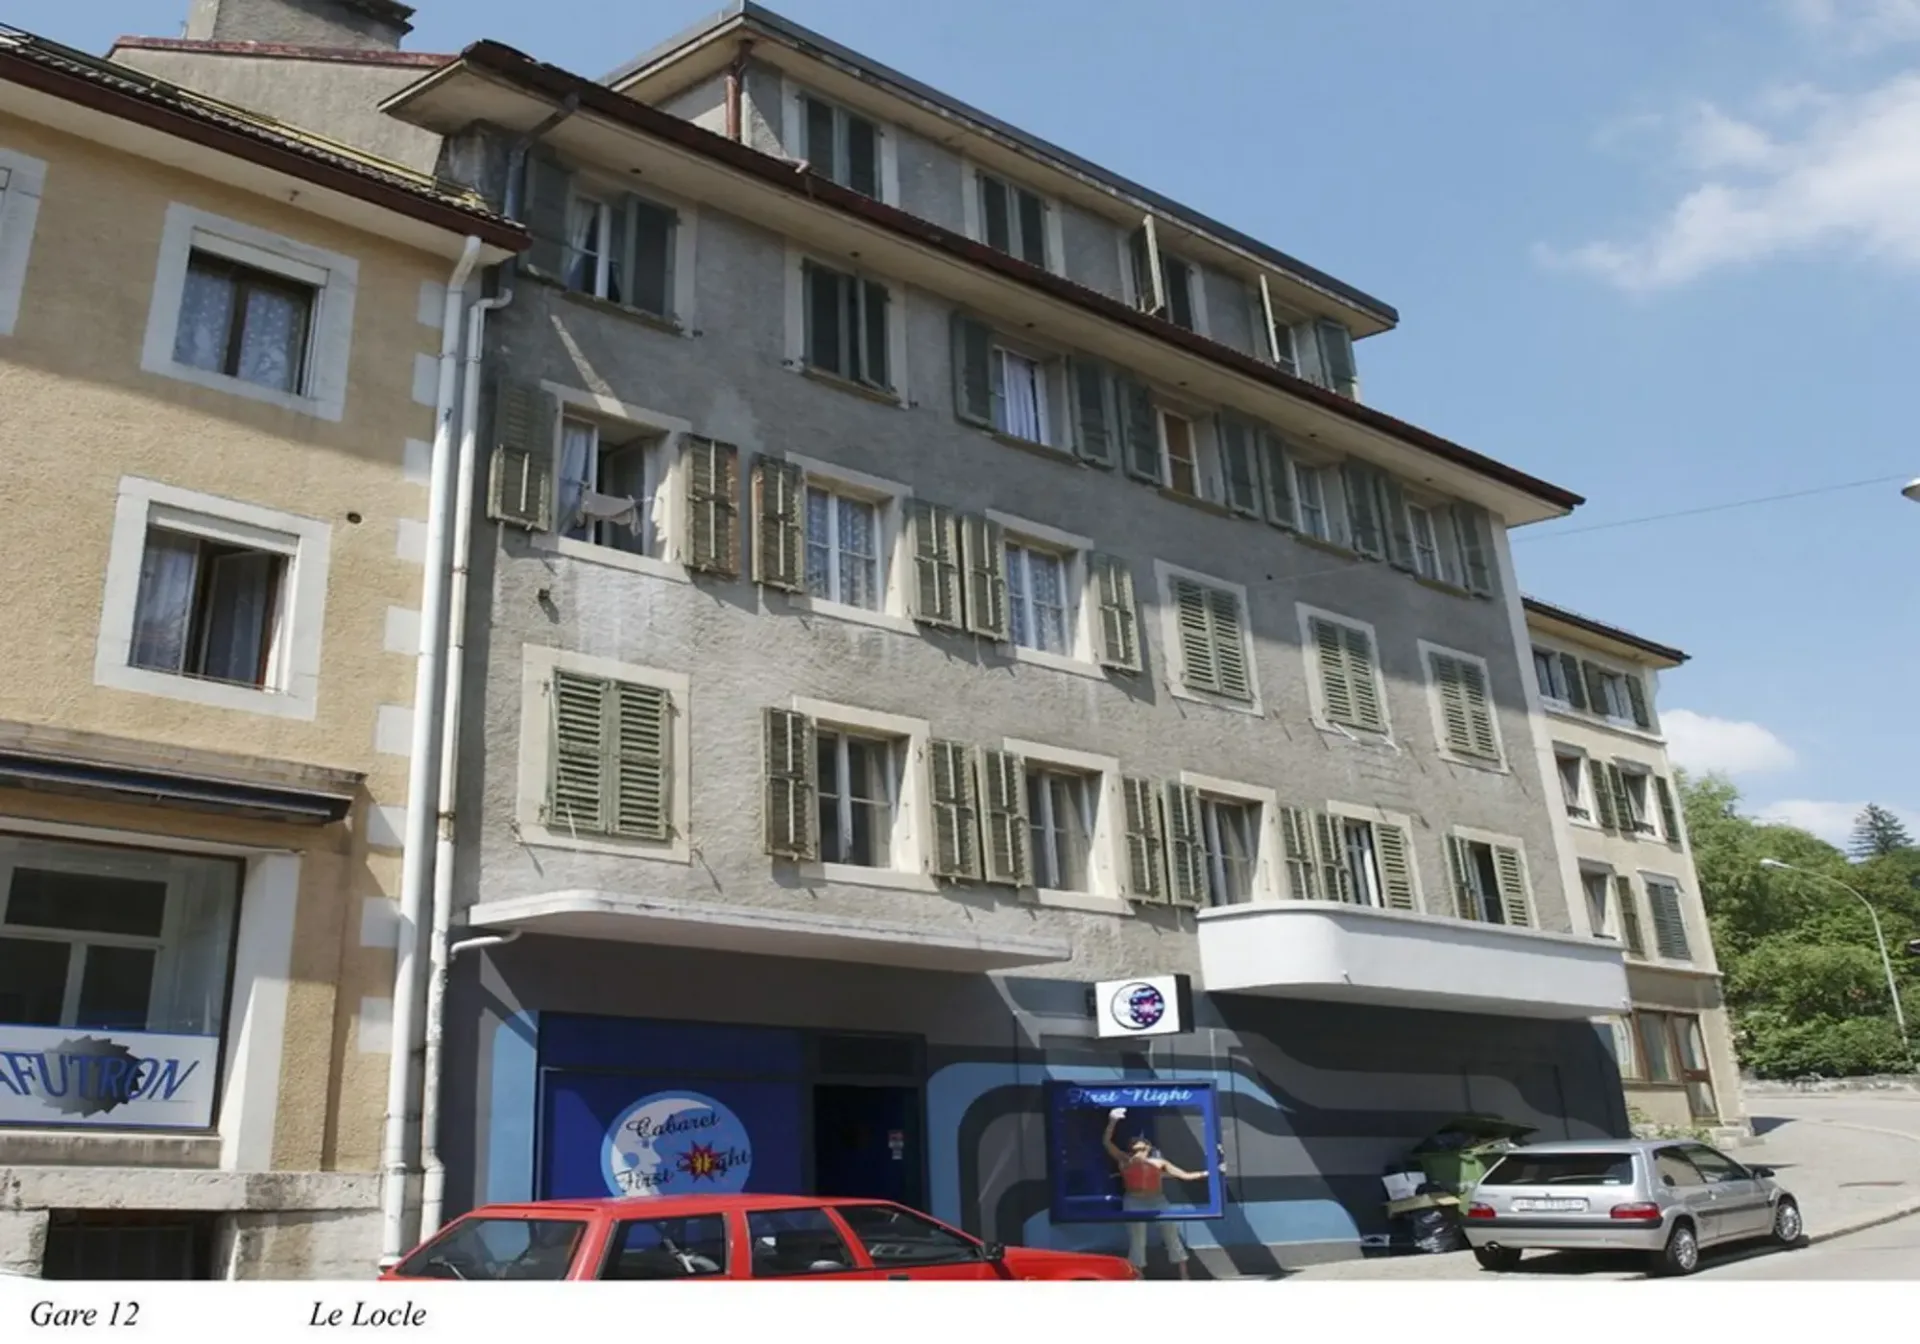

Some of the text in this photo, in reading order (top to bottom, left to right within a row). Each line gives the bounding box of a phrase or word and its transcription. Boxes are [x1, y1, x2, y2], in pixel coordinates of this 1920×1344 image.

[1122, 1087, 1193, 1106] Night
[626, 1111, 719, 1138] Cabaret
[675, 1146, 751, 1177] ght
